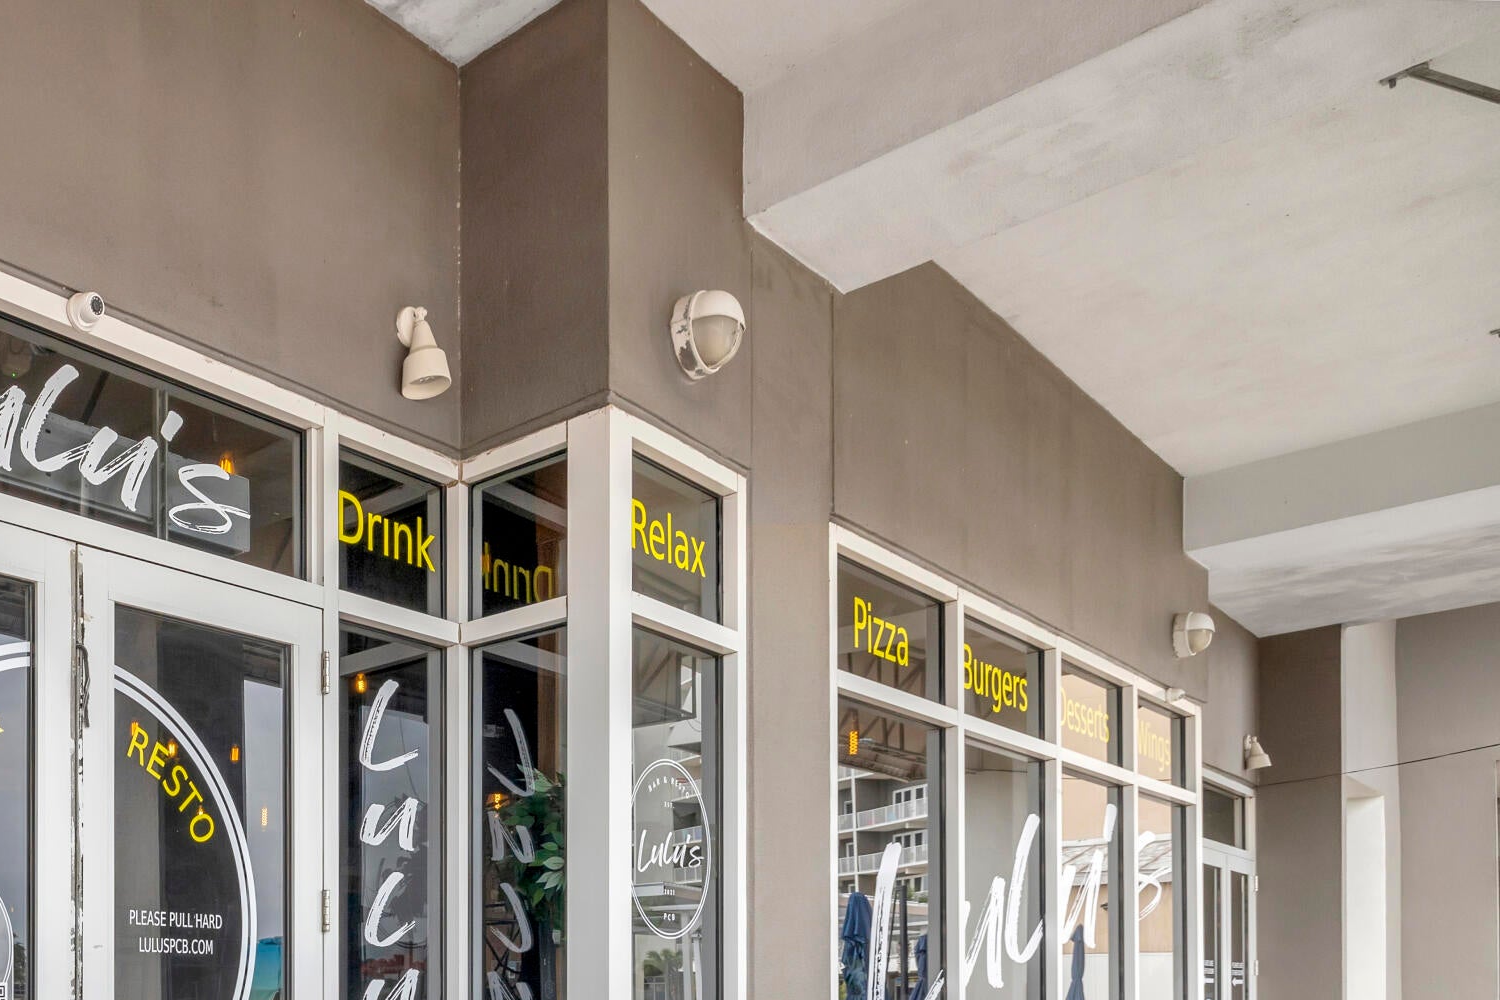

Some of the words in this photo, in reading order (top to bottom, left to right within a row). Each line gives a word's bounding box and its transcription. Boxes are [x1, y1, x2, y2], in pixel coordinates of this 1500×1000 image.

[338, 489, 436, 573] Drink
[631, 498, 706, 578] Relax
[853, 597, 909, 667] Pizza
[963, 643, 1028, 713] Burgers
[126, 725, 215, 843] RESTO
[129, 909, 167, 927] PLEASE
[169, 912, 193, 928] PULL
[195, 913, 223, 929] HARD
[139, 937, 214, 955] LULUSPCB.COM
